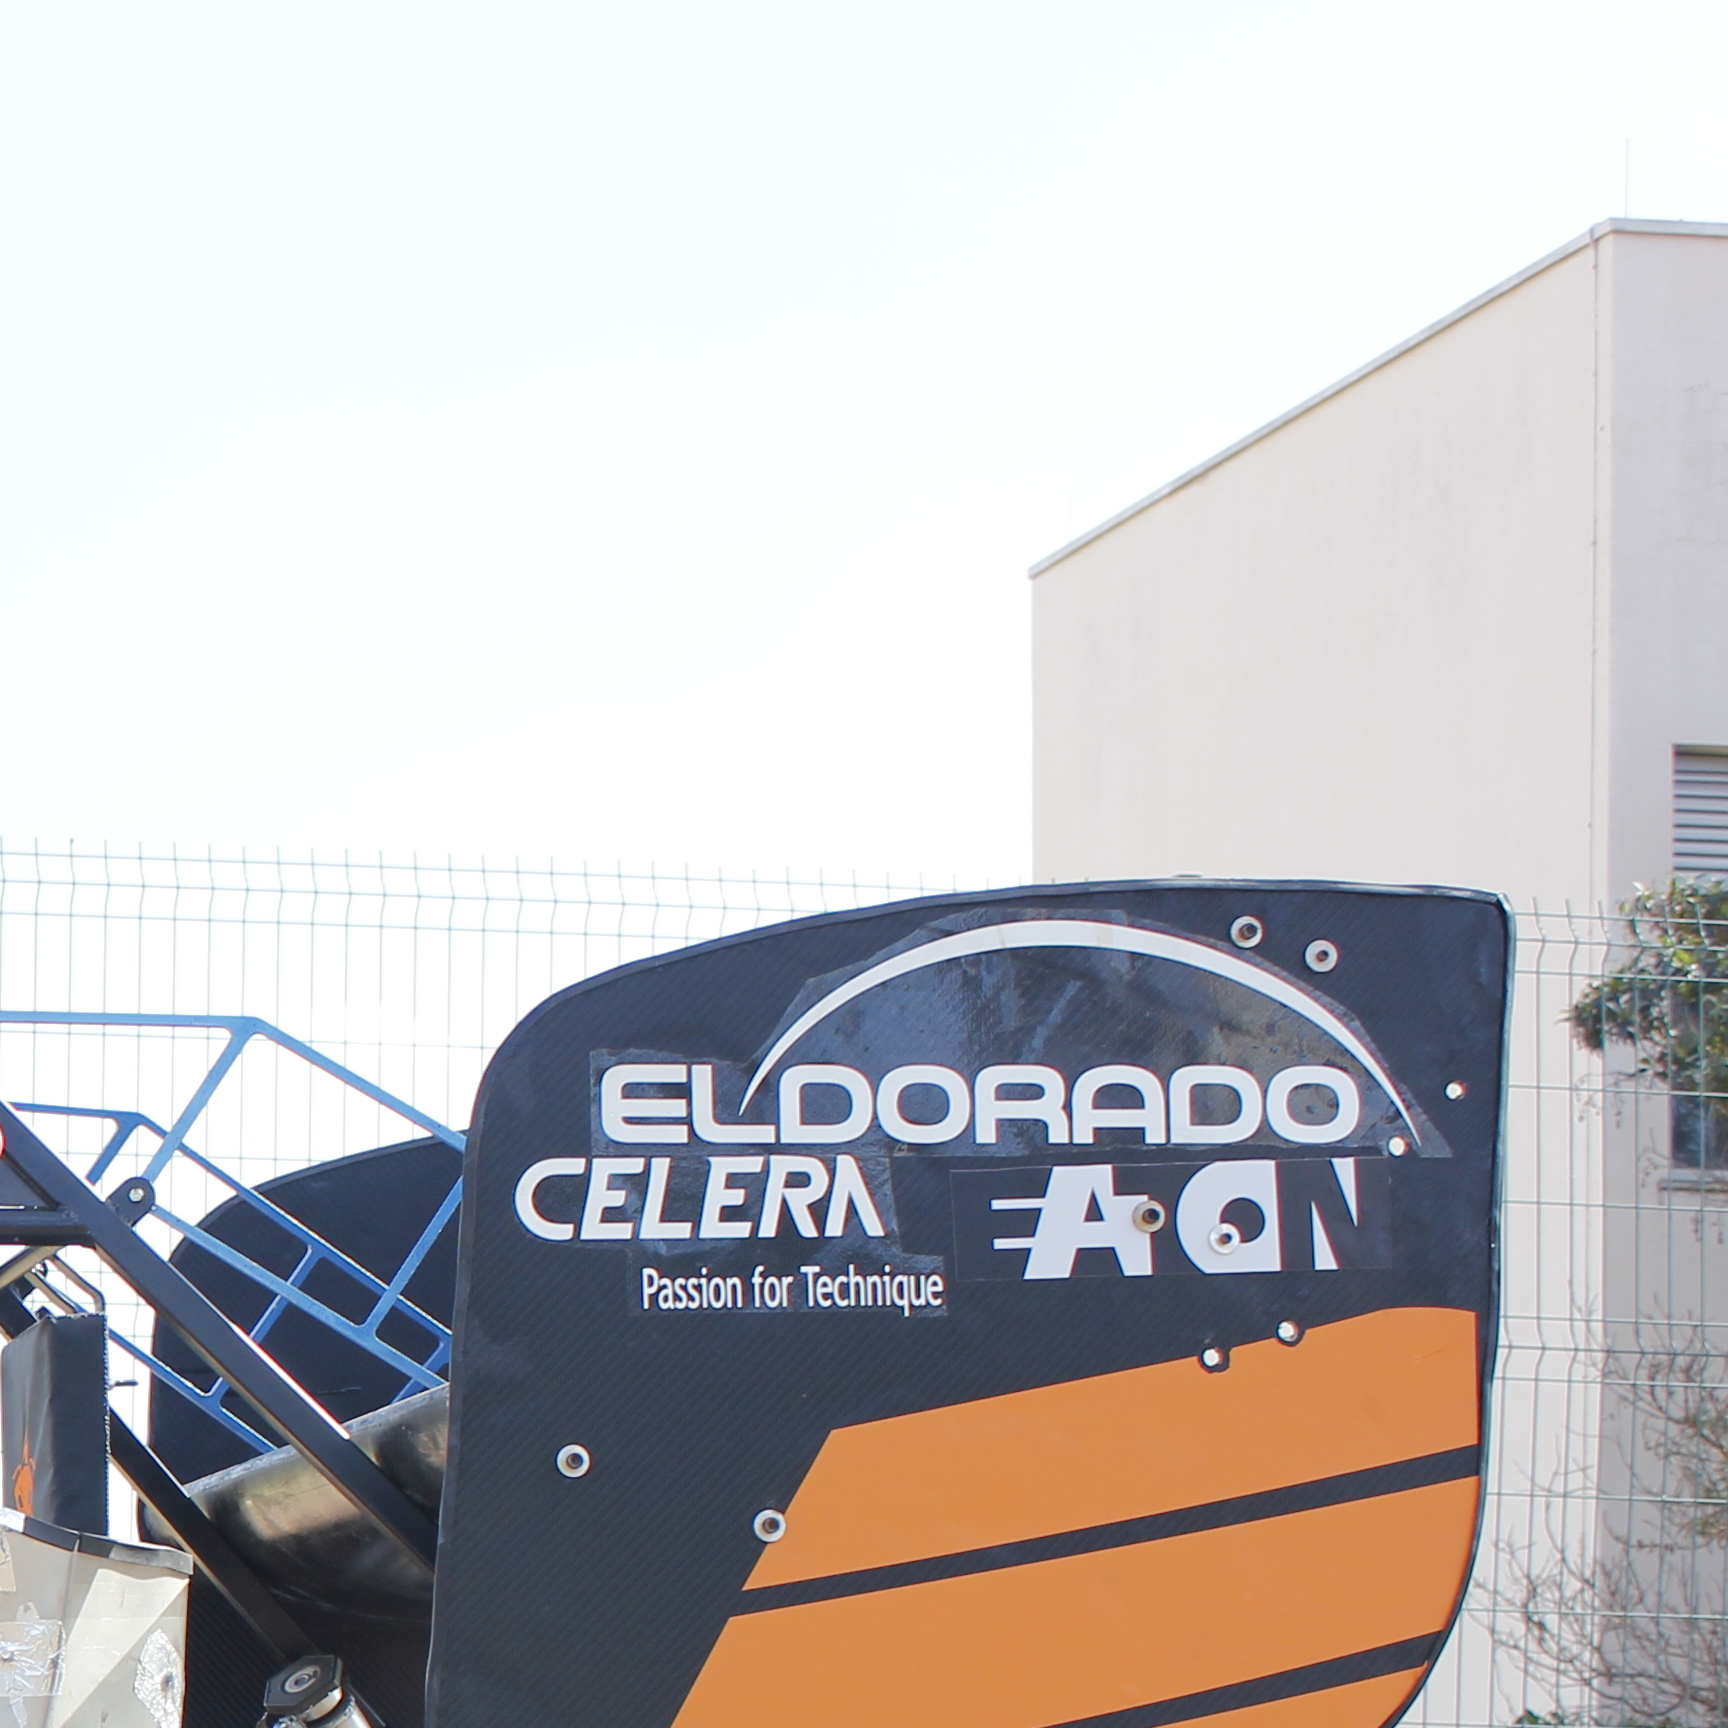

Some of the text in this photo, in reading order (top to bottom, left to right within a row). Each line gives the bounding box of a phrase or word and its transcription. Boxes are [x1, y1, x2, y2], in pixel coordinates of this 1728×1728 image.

[598, 1063, 1361, 1146] ELDORADO
[512, 1153, 888, 1241] CELERA
[640, 1262, 945, 1318] Passion for Technique
